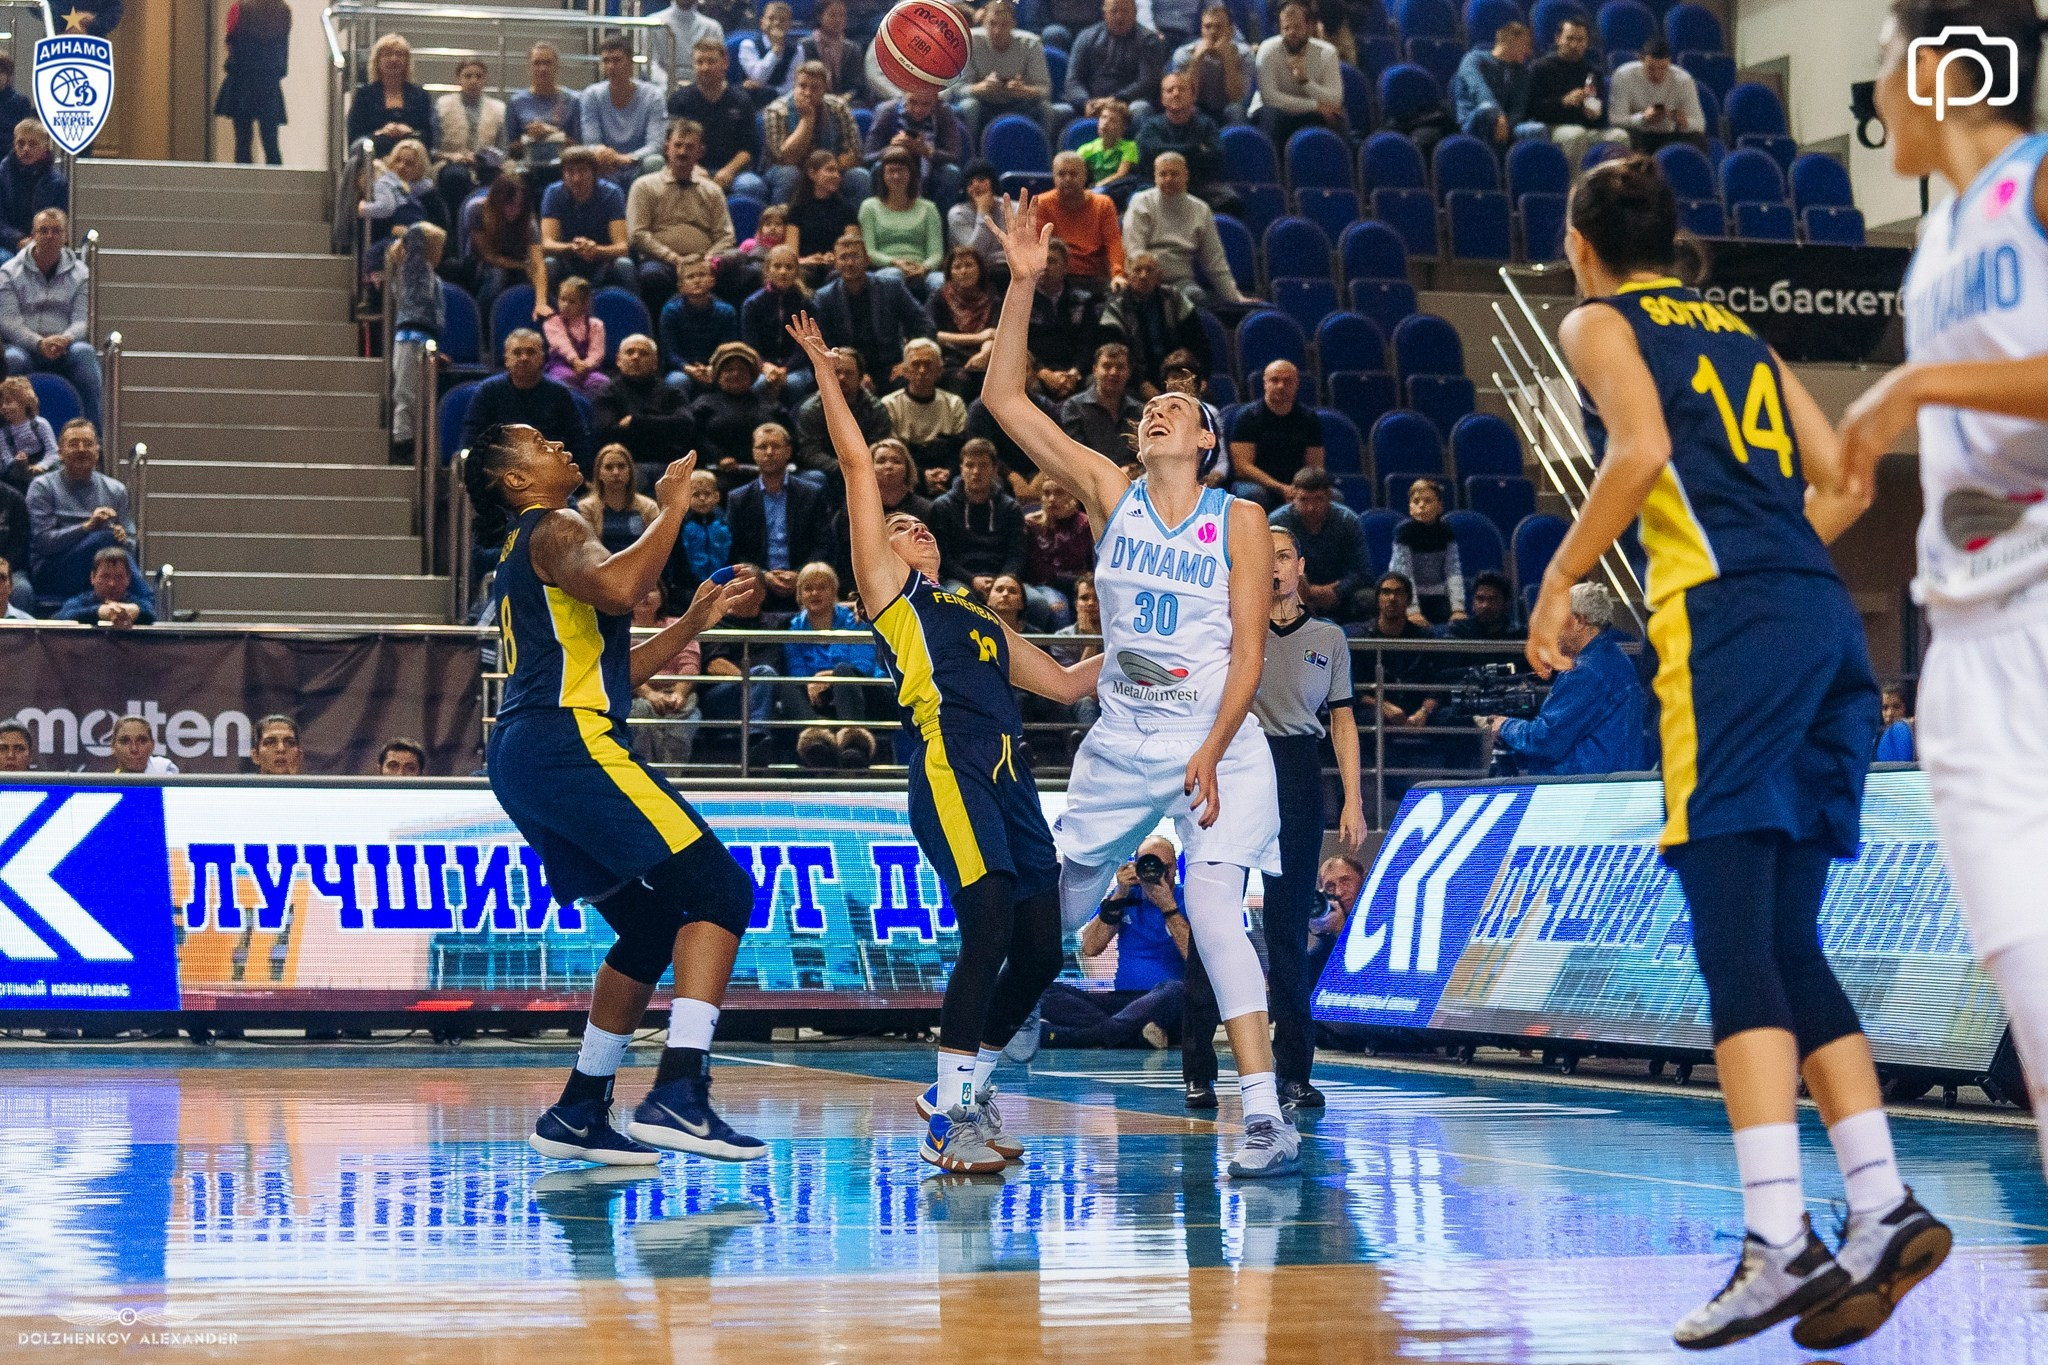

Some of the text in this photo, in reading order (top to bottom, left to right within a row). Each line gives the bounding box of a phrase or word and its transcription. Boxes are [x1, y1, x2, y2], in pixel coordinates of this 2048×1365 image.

[913, 7, 960, 48] molten
[1687, 280, 1904, 317] есьбаскет
[1691, 354, 1793, 478] 14
[1110, 536, 1217, 589] DYNAMO
[1133, 591, 1179, 636] 30
[1112, 680, 1199, 702] Metalloinvest
